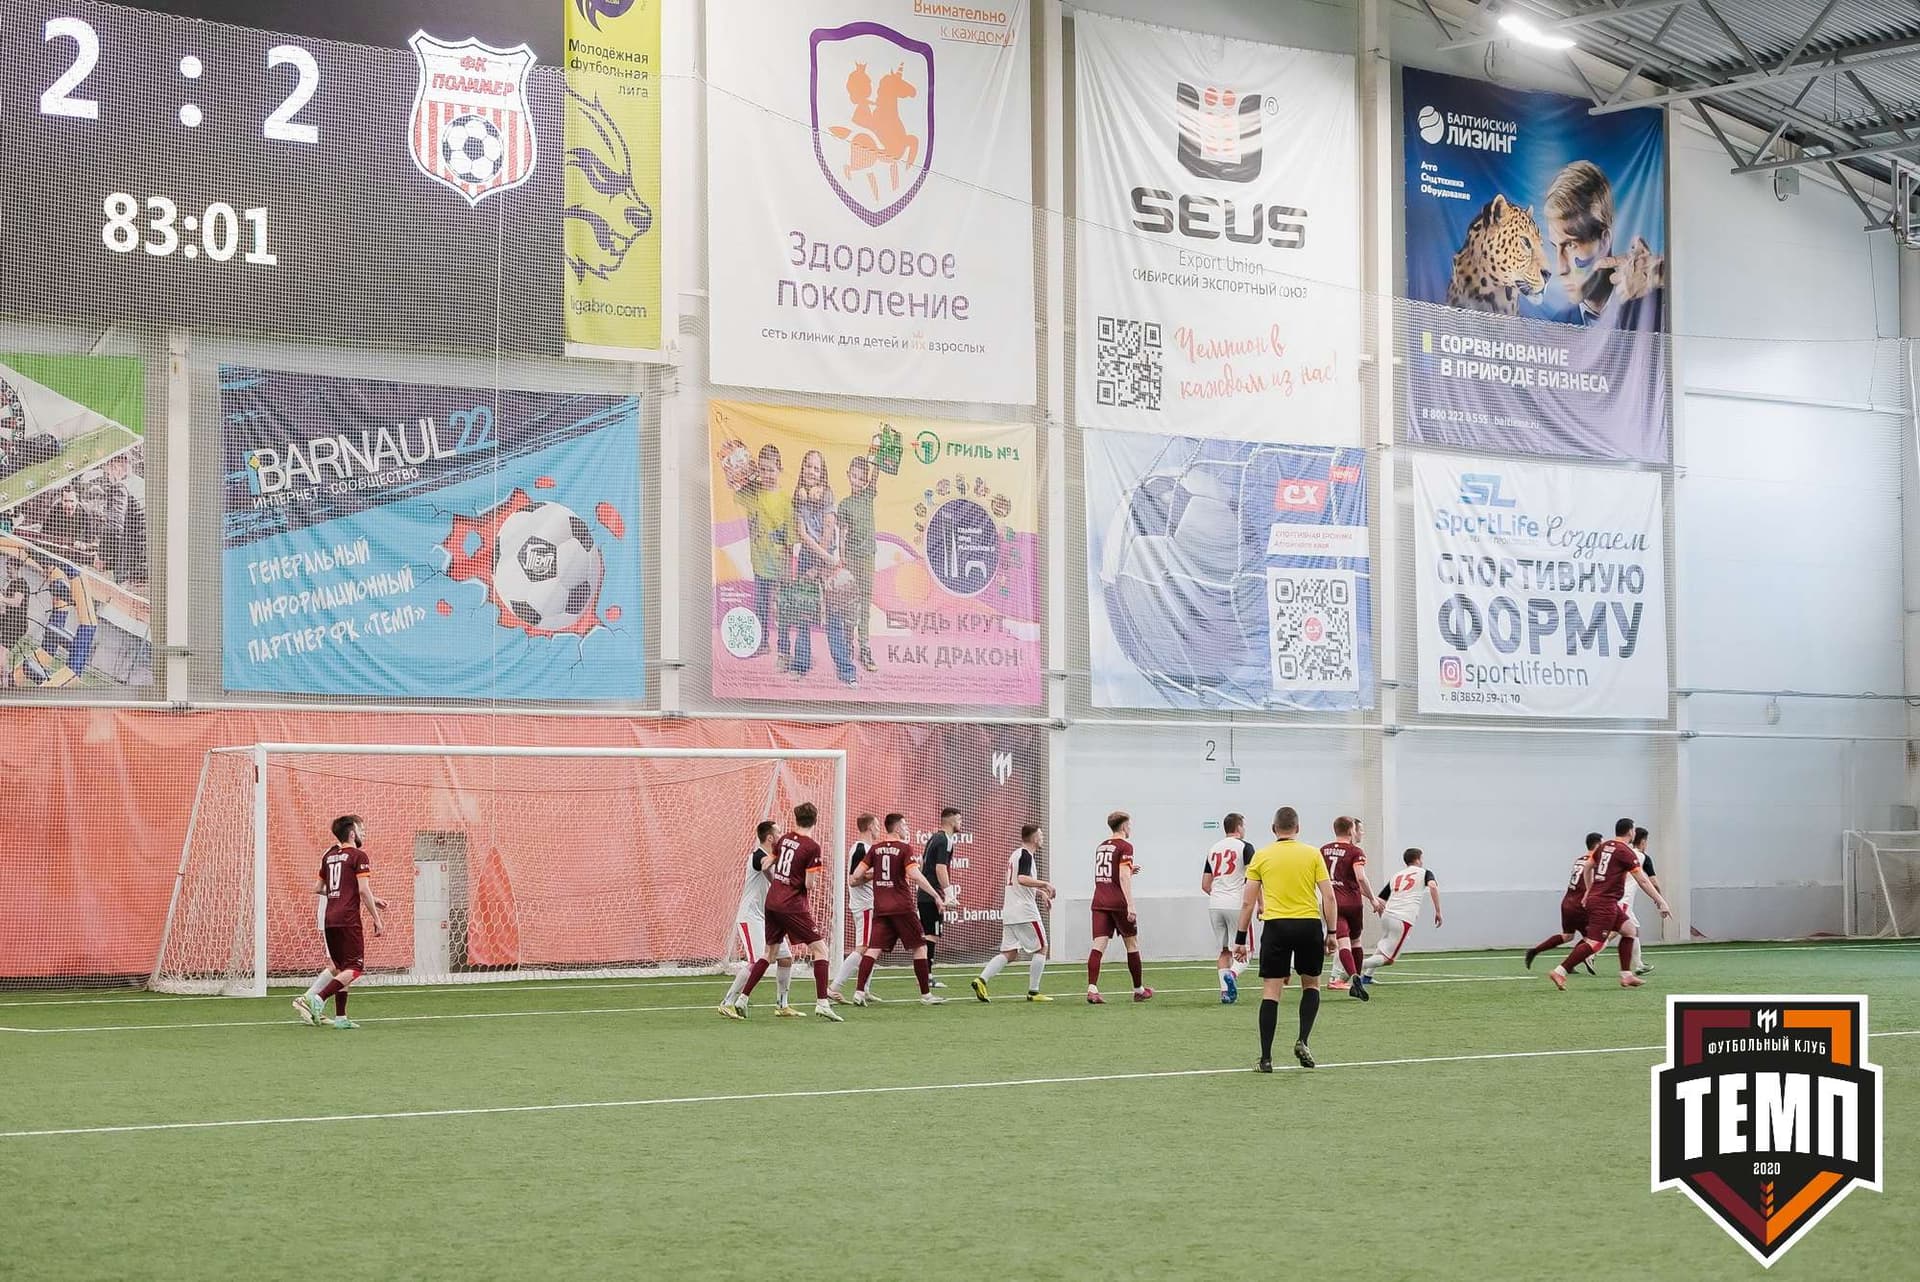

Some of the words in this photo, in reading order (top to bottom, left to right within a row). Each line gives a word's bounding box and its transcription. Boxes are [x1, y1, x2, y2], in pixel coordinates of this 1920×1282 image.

[914, 0, 1007, 24] Внимательно
[460, 55, 488, 72] ФК
[568, 38, 649, 65] Молодёжная
[39, 17, 99, 120] 2
[263, 45, 320, 144] 2
[570, 56, 649, 81] футбольная
[432, 72, 515, 97] ПОЛИМЕР
[617, 85, 649, 98] лига
[1447, 112, 1517, 135] БАЛТИЙСКИЙ
[1446, 125, 1517, 154] ЛИЗИНГ
[102, 191, 277, 266] 83:01
[1131, 186, 1308, 249] SEUS
[789, 230, 956, 280] Здоровое
[1179, 250, 1222, 272] Export
[1226, 257, 1263, 275] Union
[1133, 268, 1199, 288] СИБИРСКИЙ
[1202, 275, 1276, 297] ЭКСПОРТНЫЙ
[1279, 285, 1308, 298] СОЮЗ
[777, 279, 970, 321] поколение
[761, 327, 788, 340] сеть
[791, 330, 835, 345] клиник
[837, 334, 860, 347] для
[863, 335, 898, 349] детей
[902, 339, 909, 350] и
[929, 341, 985, 354] взрослых
[1174, 327, 1268, 363] Чемпион
[1270, 323, 1287, 358] в
[1441, 335, 1569, 366] СОРЕВНОВАНИЕ
[1180, 363, 1267, 400] каждом
[1272, 369, 1294, 397] из
[1441, 359, 1451, 376] В
[1457, 360, 1535, 388] ПРИРОДЕ
[1537, 370, 1610, 393] БИЗНЕСА
[946, 443, 993, 459] ГРИЛЬ
[997, 446, 1020, 461] №1
[253, 486, 318, 509] ИНТЕРНЕТ
[331, 467, 419, 495] СООБЩЕСТВО
[1458, 473, 1516, 508] SL
[1435, 508, 1539, 537] SportLife
[1546, 514, 1650, 559] Создаем
[248, 536, 370, 585] ГЕНЕРАЛЬНЫЙ
[1437, 553, 1645, 595] СПОРТИВНУЮ
[249, 563, 415, 627] ИНФОРМАЦИОННЫЙ
[248, 626, 326, 665] ПАРТНЕР
[330, 618, 360, 644] ФК
[364, 605, 426, 637] «ТЕМП»
[1438, 593, 1644, 658] ФОРМУ
[888, 644, 928, 664] КАК
[934, 646, 1023, 668] ДРАКОН!
[1465, 660, 1589, 688] sportlifebrn
[1205, 740, 1216, 761] 2
[777, 846, 795, 876] 18
[882, 854, 891, 880] 9
[1096, 852, 1112, 877] 25
[1329, 855, 1338, 880] 7
